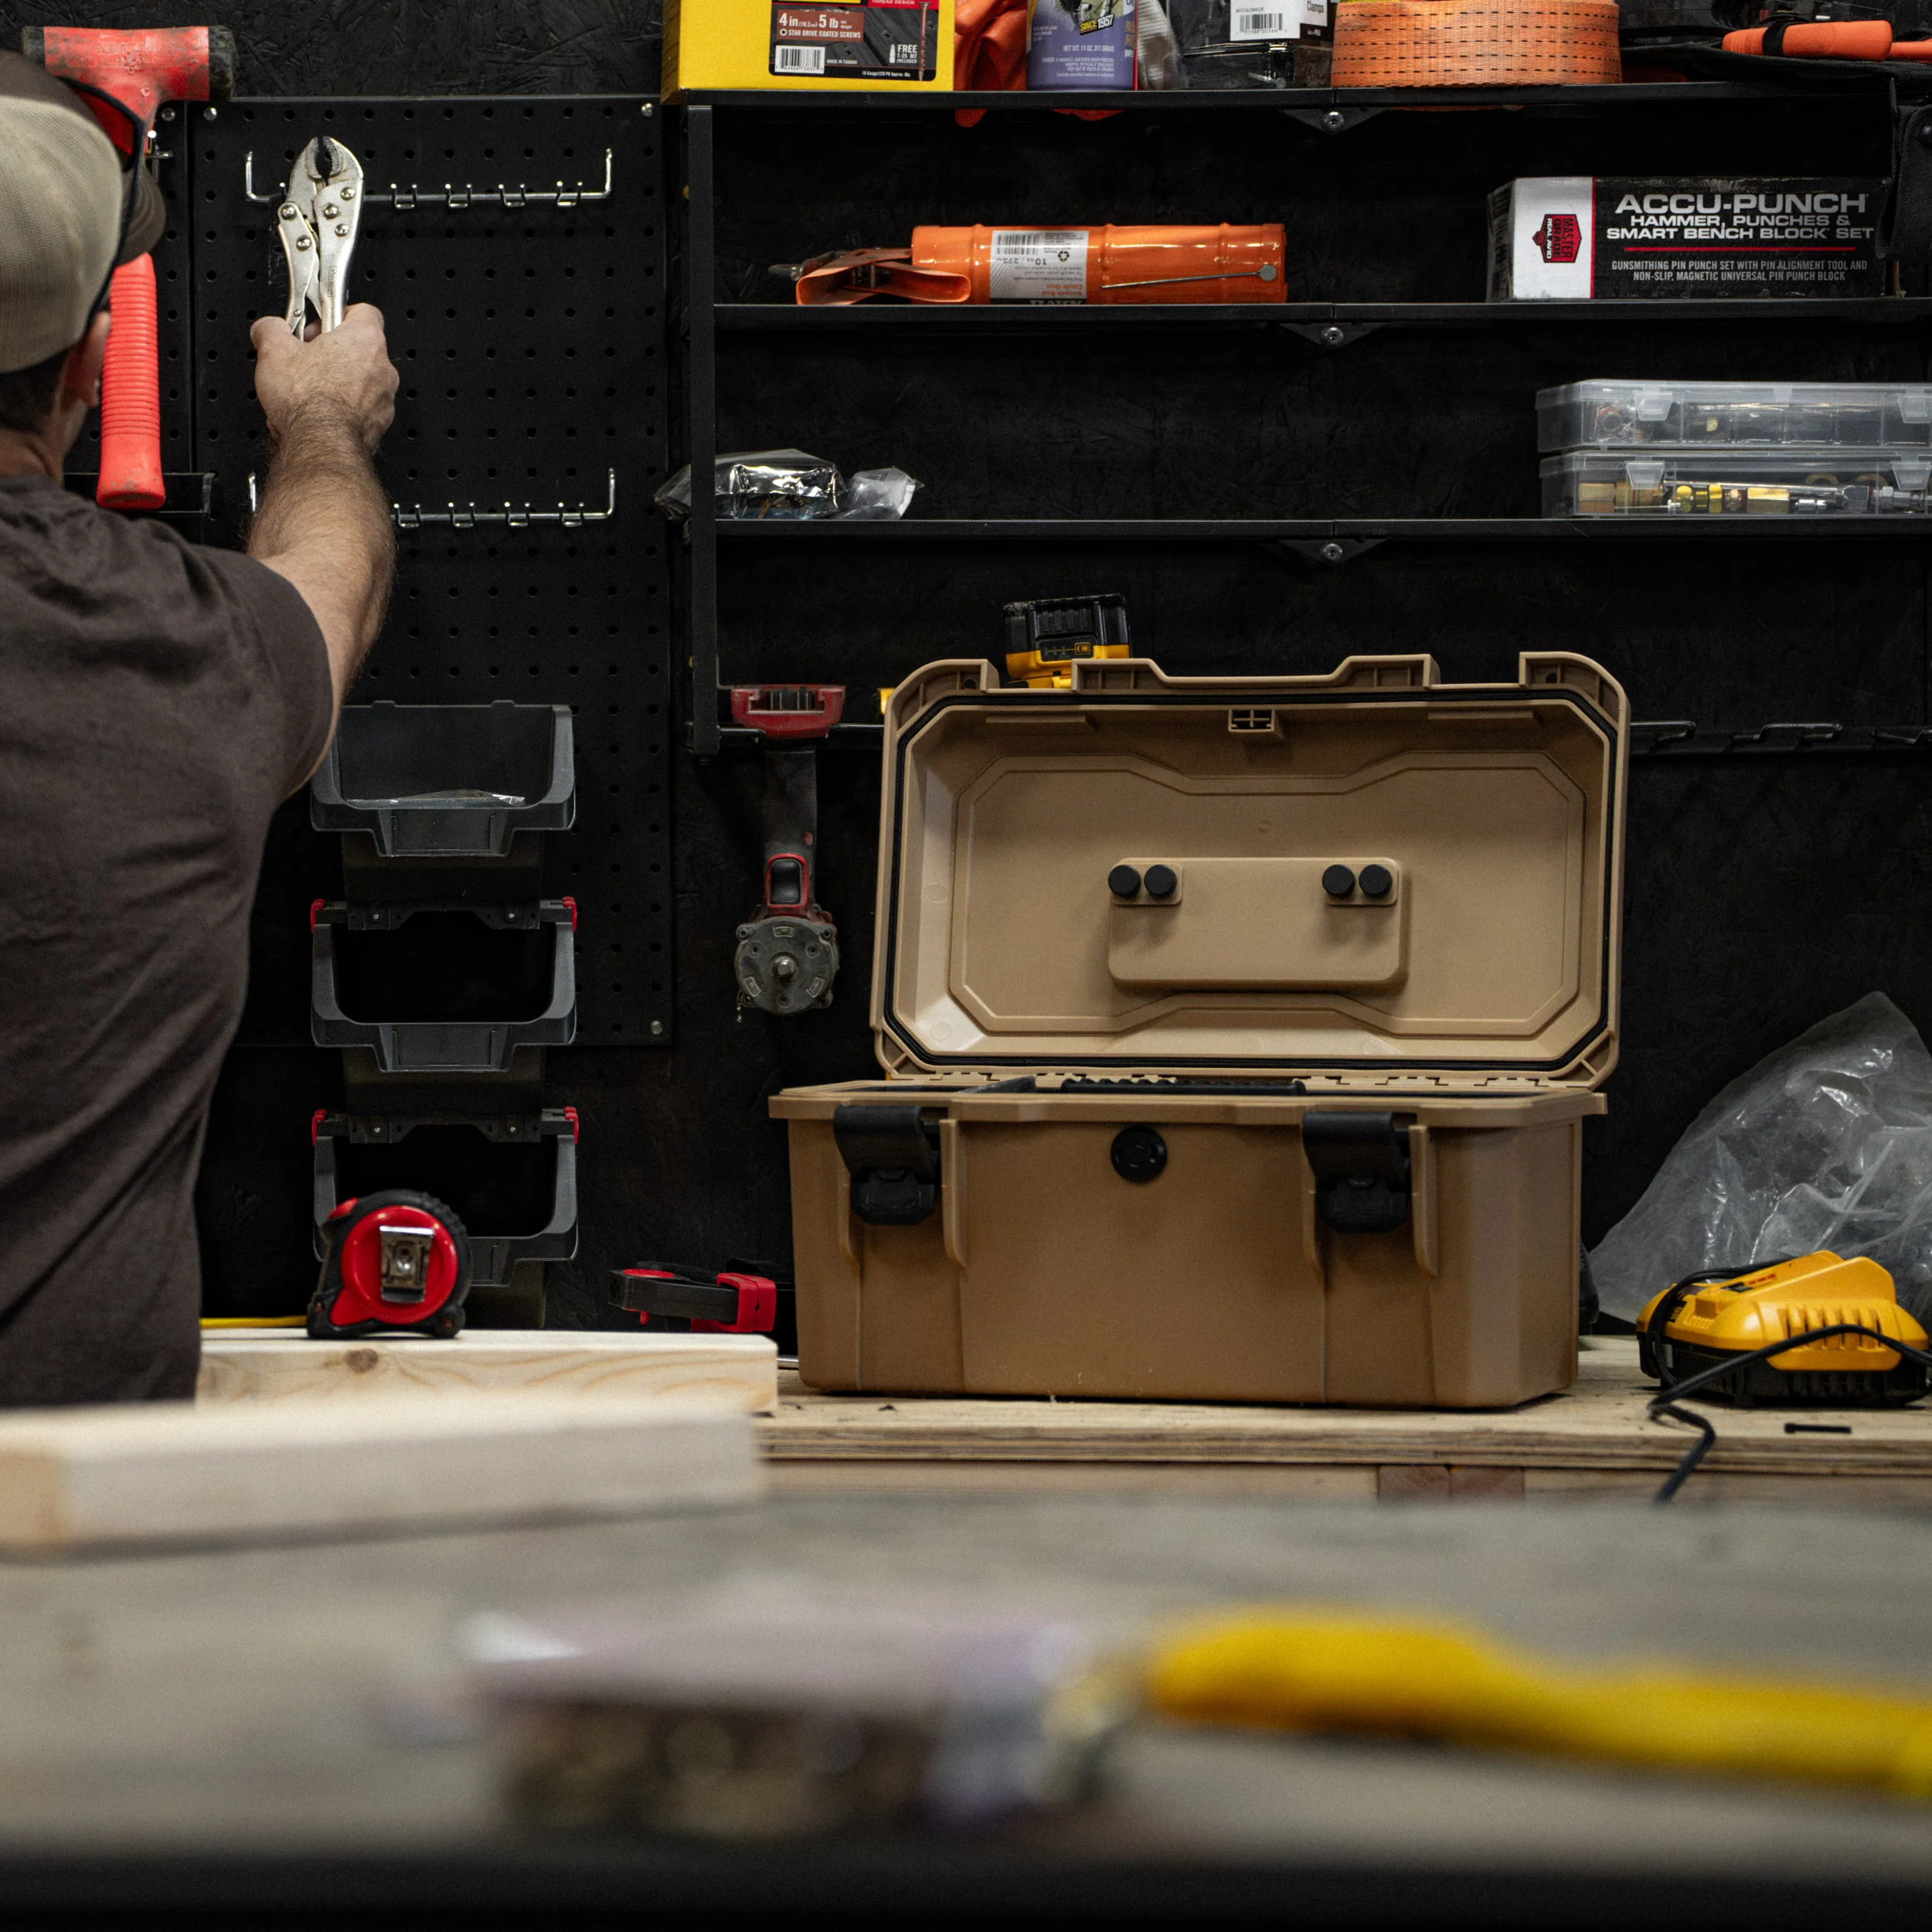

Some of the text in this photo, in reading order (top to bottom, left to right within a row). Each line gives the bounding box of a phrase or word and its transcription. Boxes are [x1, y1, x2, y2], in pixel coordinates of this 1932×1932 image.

[1307, 1, 1325, 14] Clamps
[779, 12, 787, 26] 4
[789, 16, 798, 26] in
[819, 14, 826, 28] 5
[829, 18, 838, 29] lb
[1080, 20, 1097, 32] SINCE
[1097, 15, 1114, 29] 1957
[897, 44, 917, 53] FREE
[1614, 193, 1866, 214] ACCU-PUNCH
[1631, 215, 1851, 229] HAMMER, PUNCHES &
[1562, 218, 1573, 258] MASTER
[1607, 227, 1874, 240] SMART BENCH BLOCK SET
[1611, 260, 1868, 270] GUNSMITHING PIN PUNCH SET WITH PIN ALIGNMENT TOOL AND
[1633, 271, 1845, 281] NON-SLIP, MAGNETIC UNIVERSAL PIN PUNCH BLOCK
